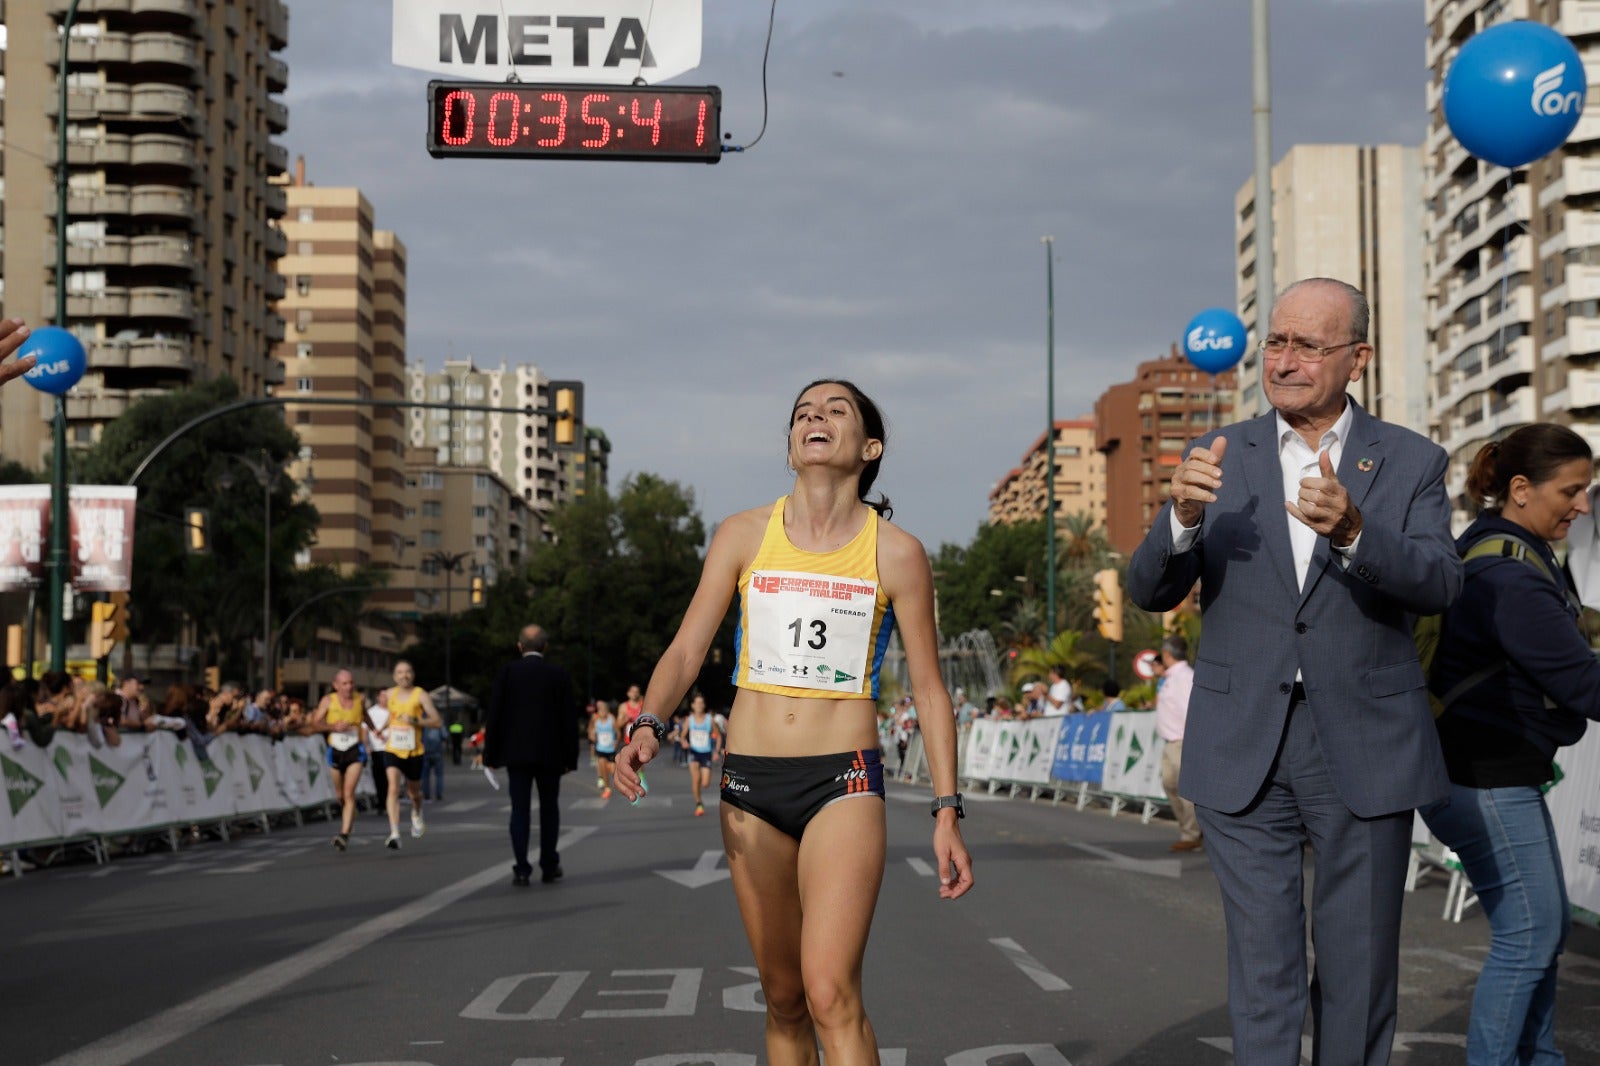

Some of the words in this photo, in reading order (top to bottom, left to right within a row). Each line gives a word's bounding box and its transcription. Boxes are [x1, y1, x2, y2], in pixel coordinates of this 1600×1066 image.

[439, 14, 658, 68] META
[442, 91, 706, 147] 00:35:41
[753, 577, 780, 593] 42
[780, 577, 830, 589] CARRERA
[832, 582, 875, 596] URBANA
[831, 607, 867, 617] FEDERADO
[788, 617, 827, 650] 13
